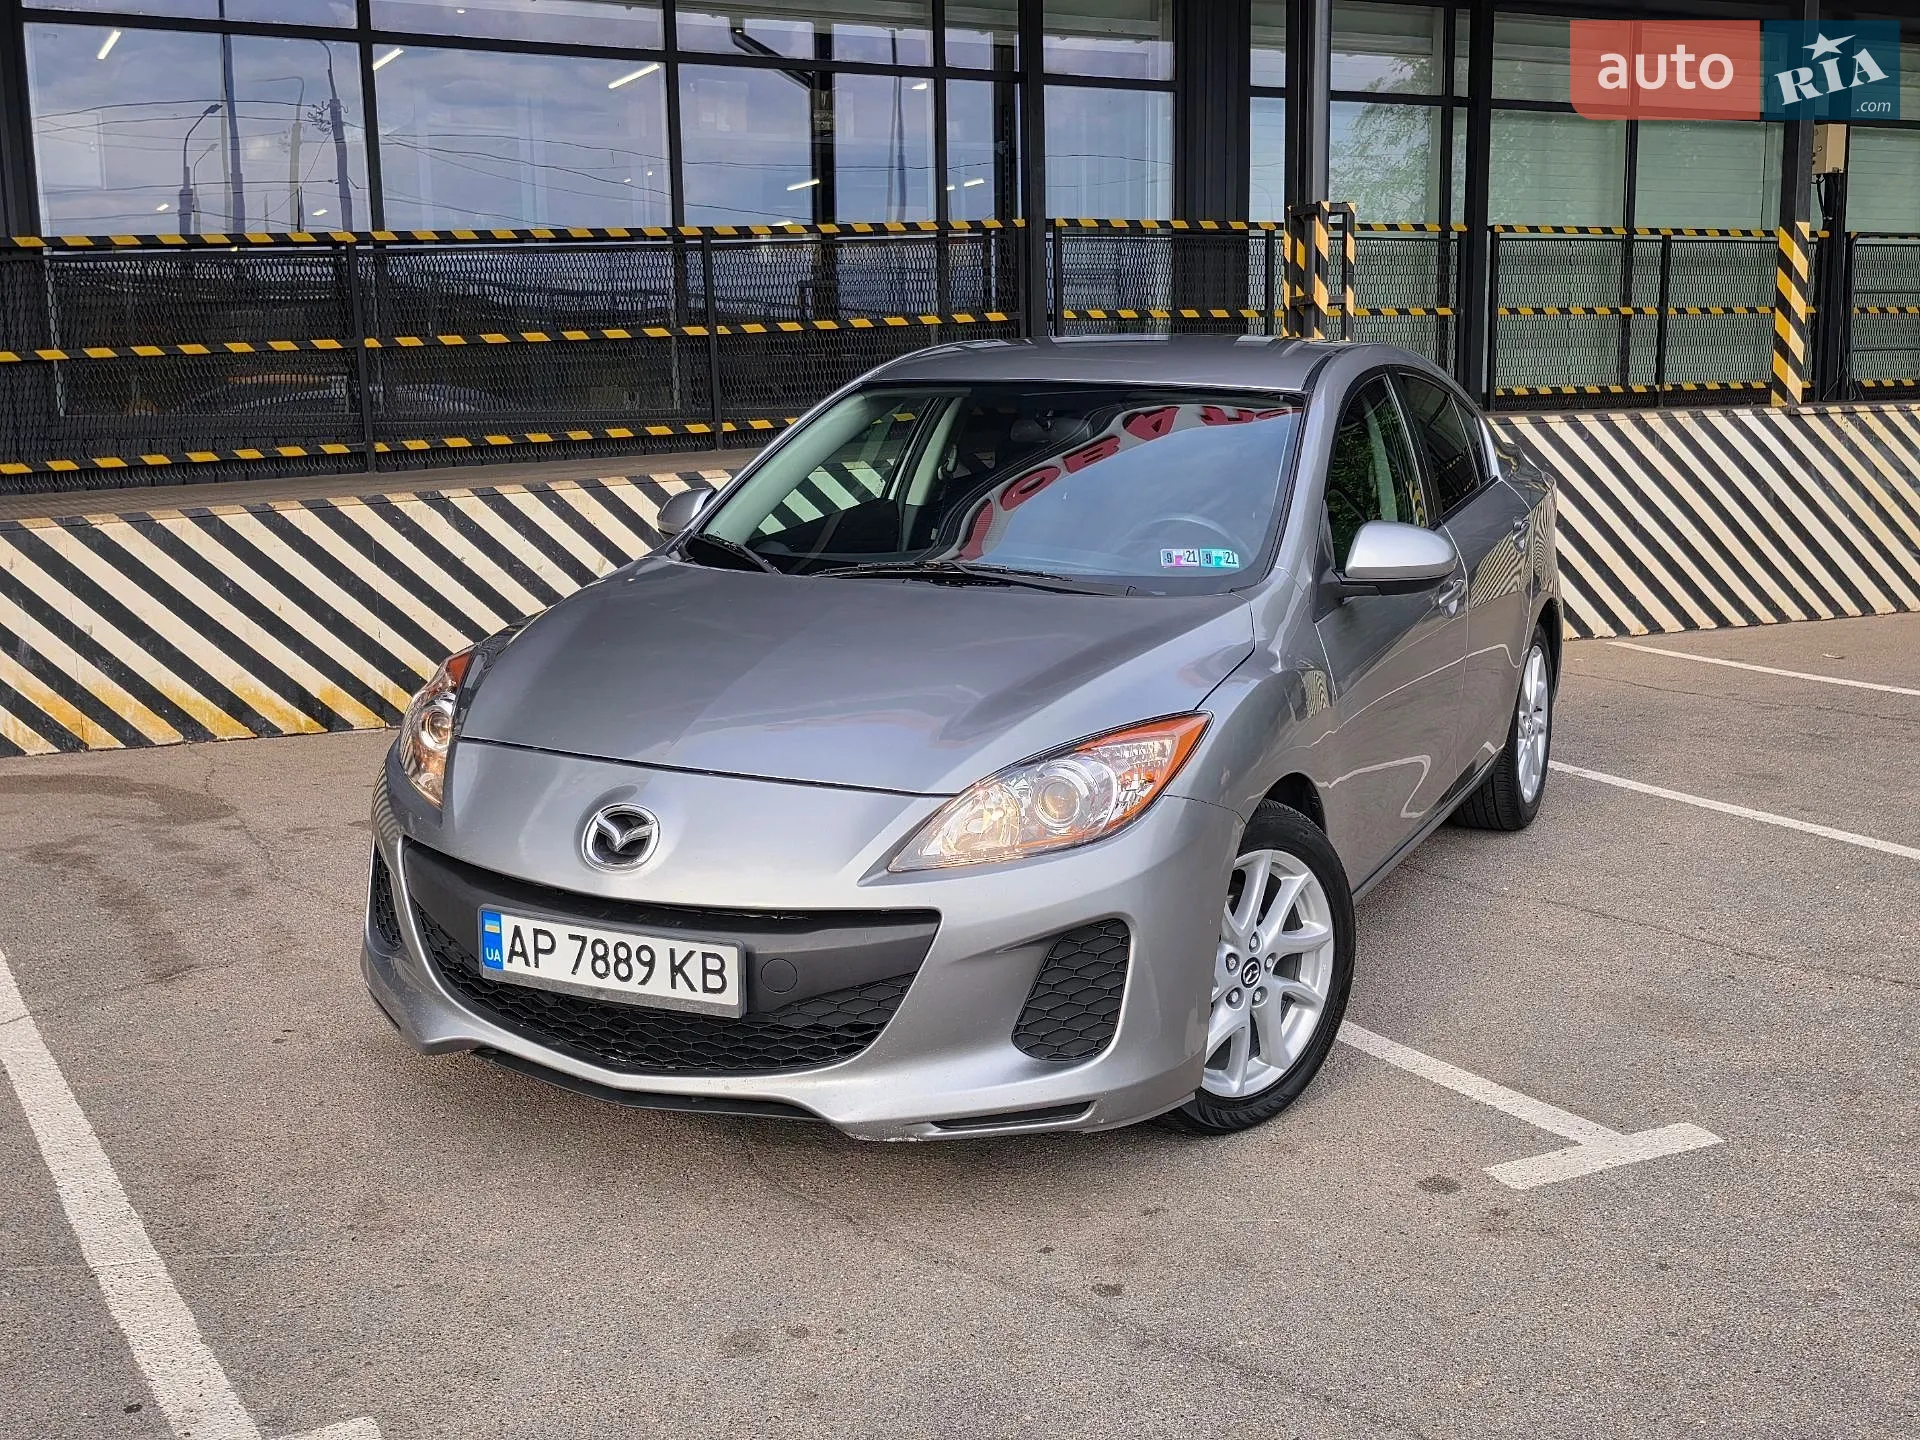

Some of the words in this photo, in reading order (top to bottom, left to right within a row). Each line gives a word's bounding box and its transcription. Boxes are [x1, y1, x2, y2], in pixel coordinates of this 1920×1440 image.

[1185, 550, 1198, 563] 21
[1225, 551, 1237, 565] 21
[485, 948, 501, 962] UA
[506, 924, 557, 969] AP
[567, 933, 656, 986] 7889
[668, 947, 728, 994] KB
